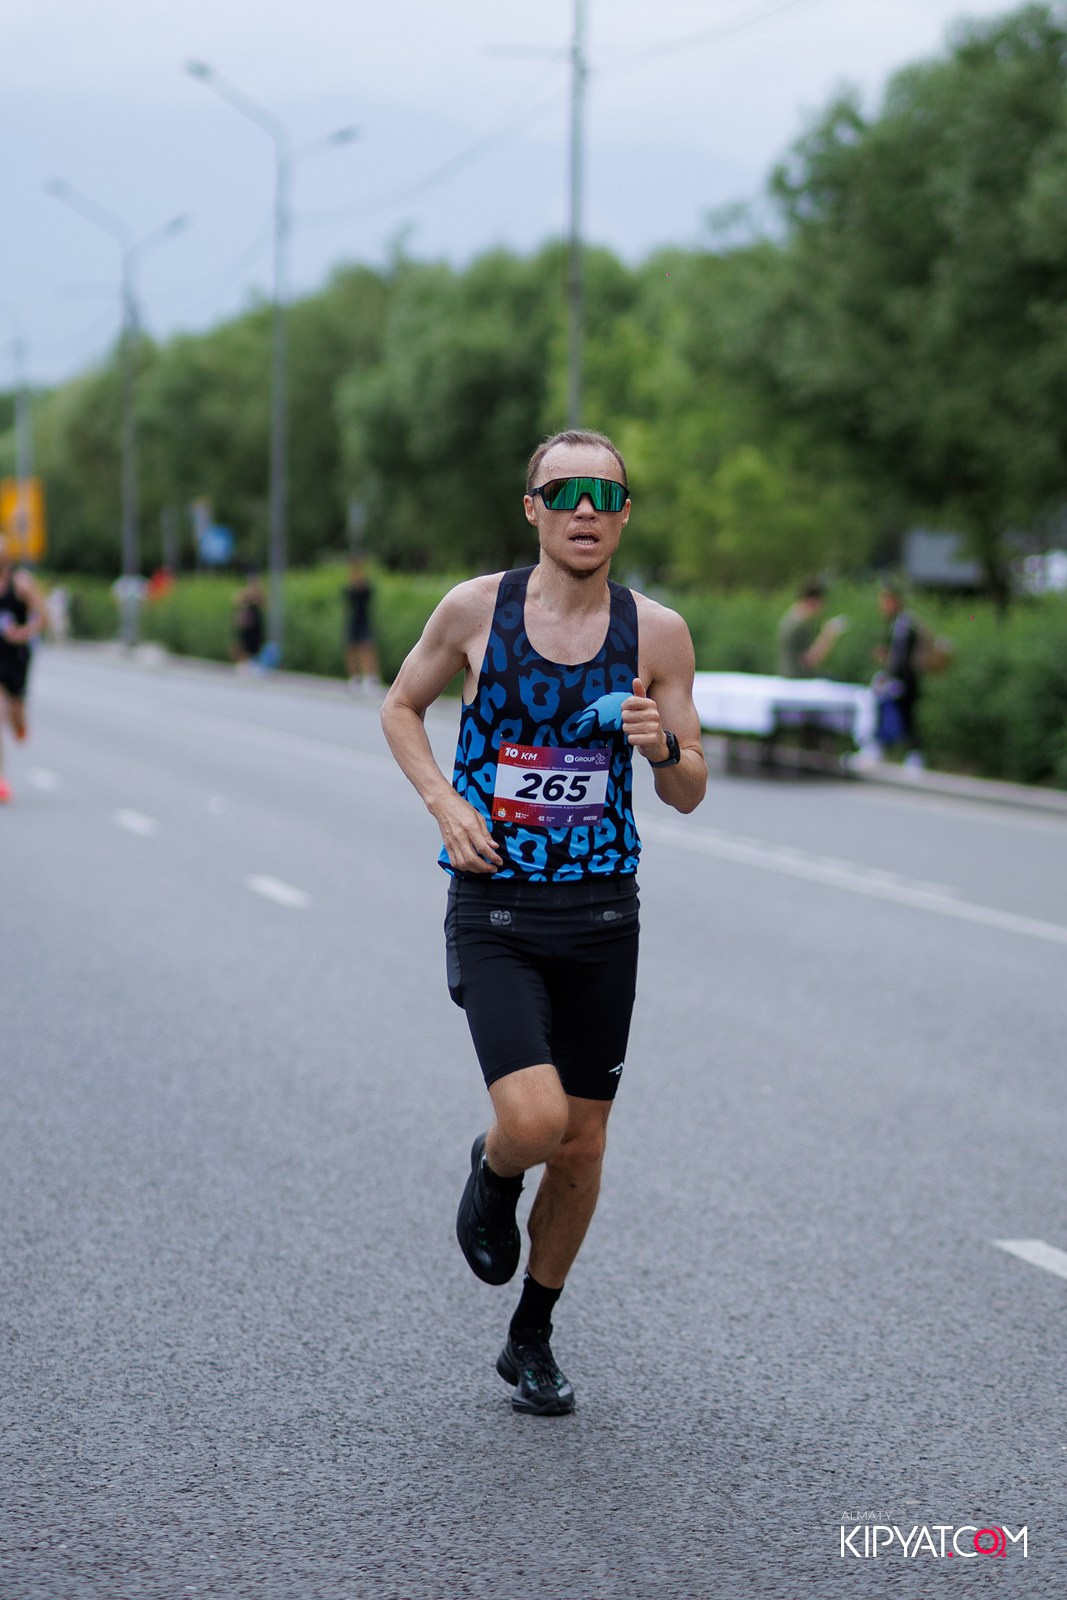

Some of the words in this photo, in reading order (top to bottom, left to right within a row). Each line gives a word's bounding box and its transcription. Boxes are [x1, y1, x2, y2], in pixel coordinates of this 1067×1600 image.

[504, 747, 519, 758] 10
[520, 752, 538, 761] KM
[574, 755, 596, 763] GROUP
[514, 772, 591, 802] 265
